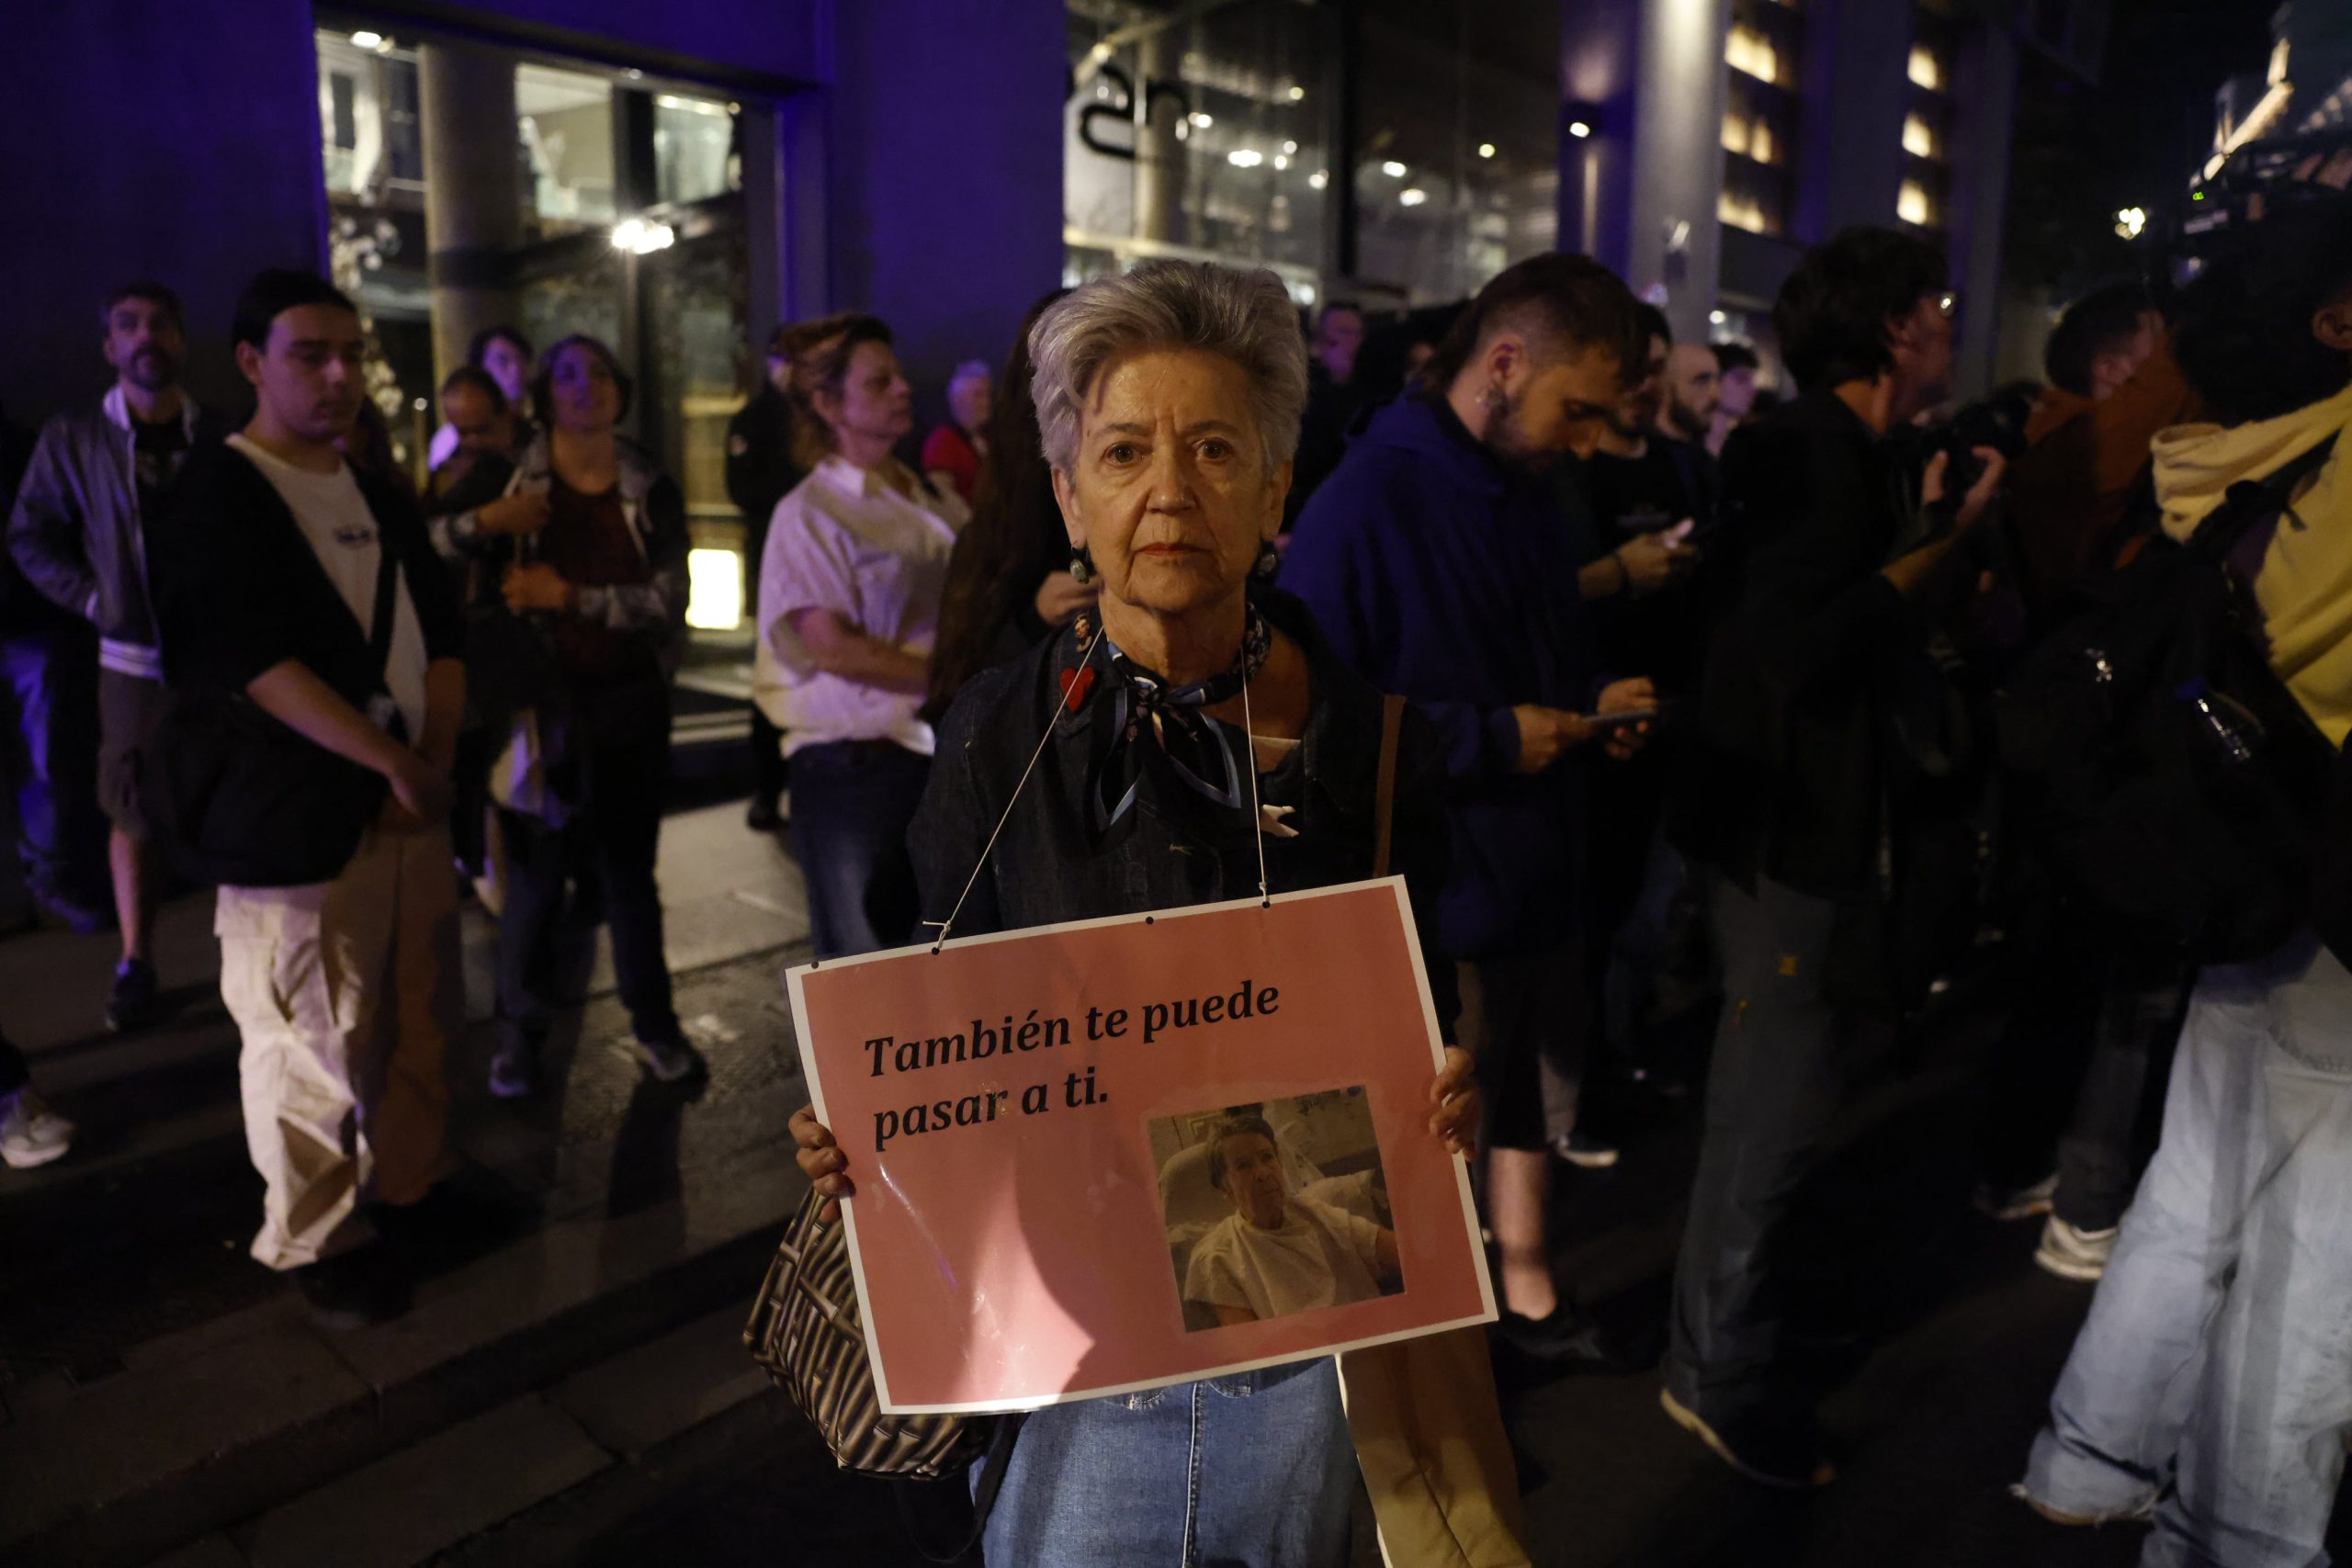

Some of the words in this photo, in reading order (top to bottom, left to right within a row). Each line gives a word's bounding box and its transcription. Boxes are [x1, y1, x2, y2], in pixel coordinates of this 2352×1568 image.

[865, 1010, 1071, 1077] También
[1085, 1004, 1129, 1042] te
[1142, 979, 1281, 1043] puede
[873, 1088, 1009, 1153] pasar
[1021, 1083, 1049, 1116] a
[1063, 1066, 1108, 1109] ti.
